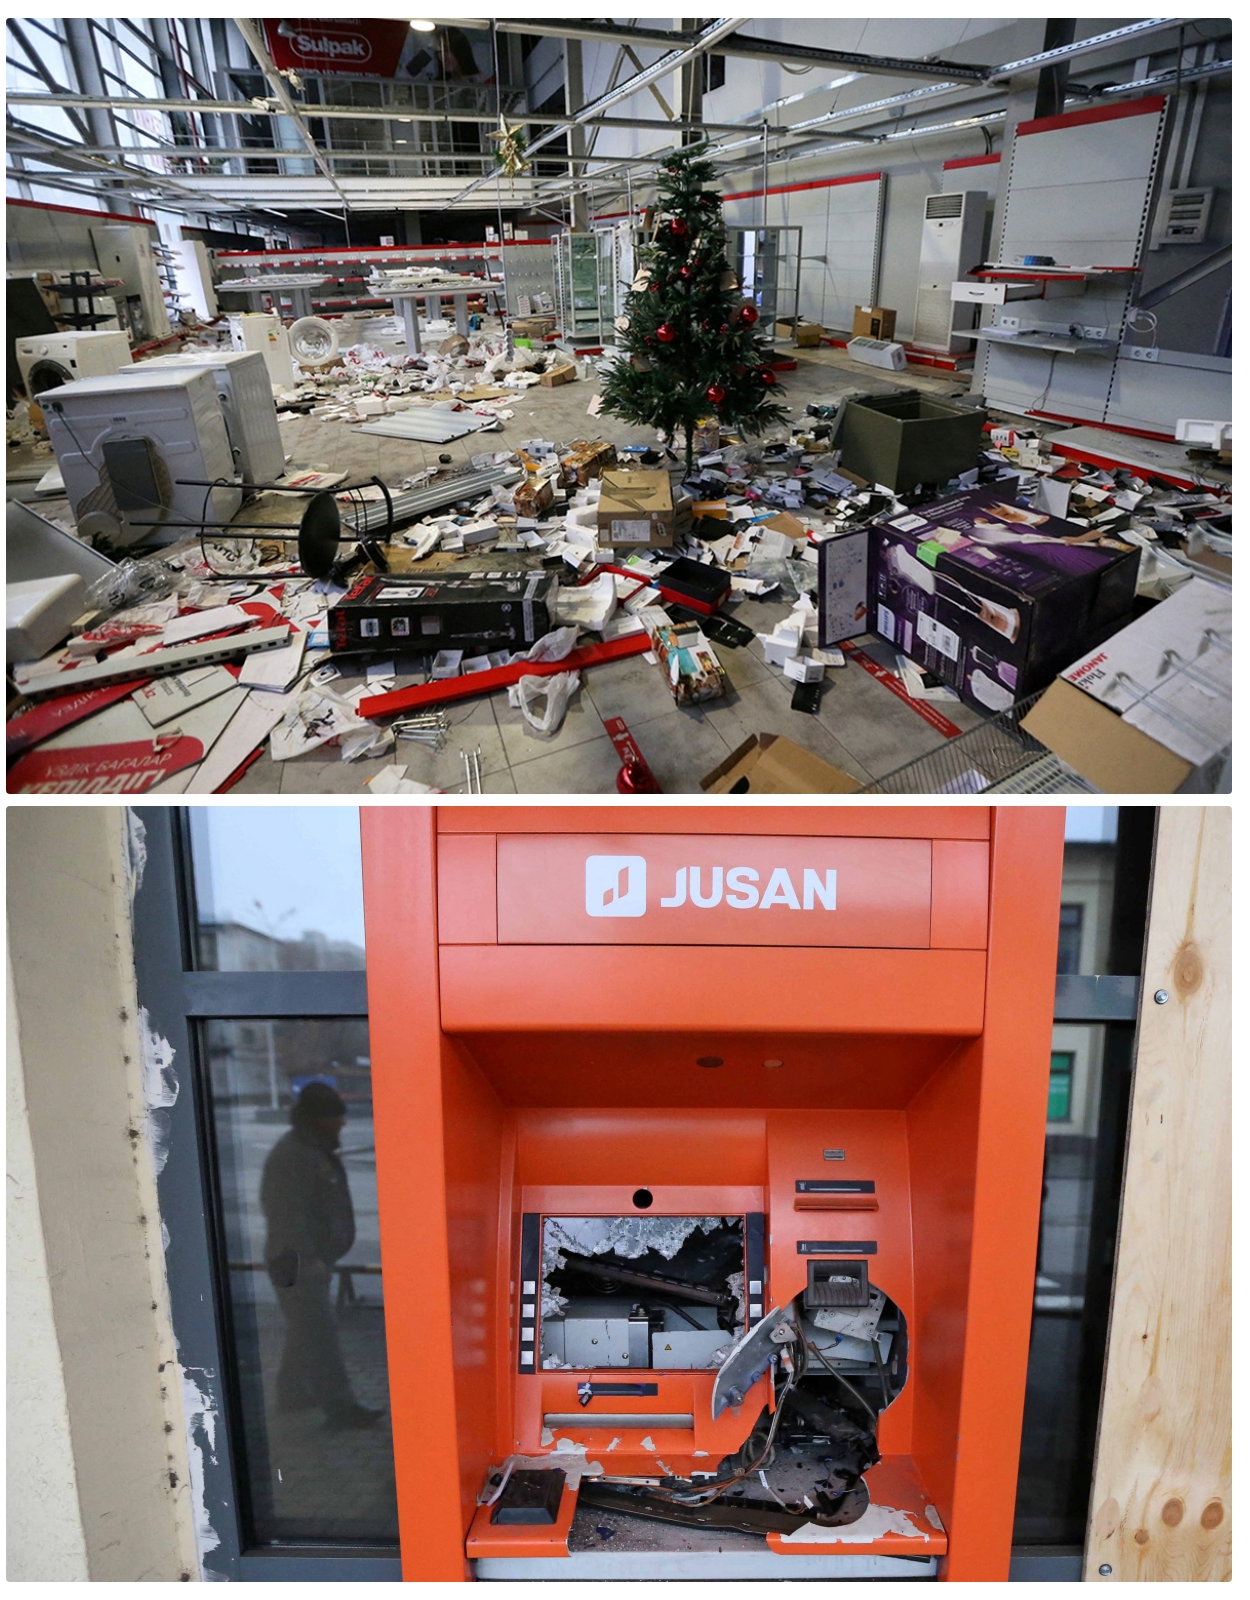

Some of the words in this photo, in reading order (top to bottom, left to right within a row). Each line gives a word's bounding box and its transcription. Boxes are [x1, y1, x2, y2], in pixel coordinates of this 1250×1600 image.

[297, 34, 366, 57] Sulpak
[341, 575, 376, 601] Tefal
[335, 609, 348, 650] Tefal
[1067, 652, 1108, 682] JANOME
[1077, 668, 1106, 690] Floki
[96, 753, 173, 773] БАҒАЛАР
[660, 866, 838, 911] JUSAN
